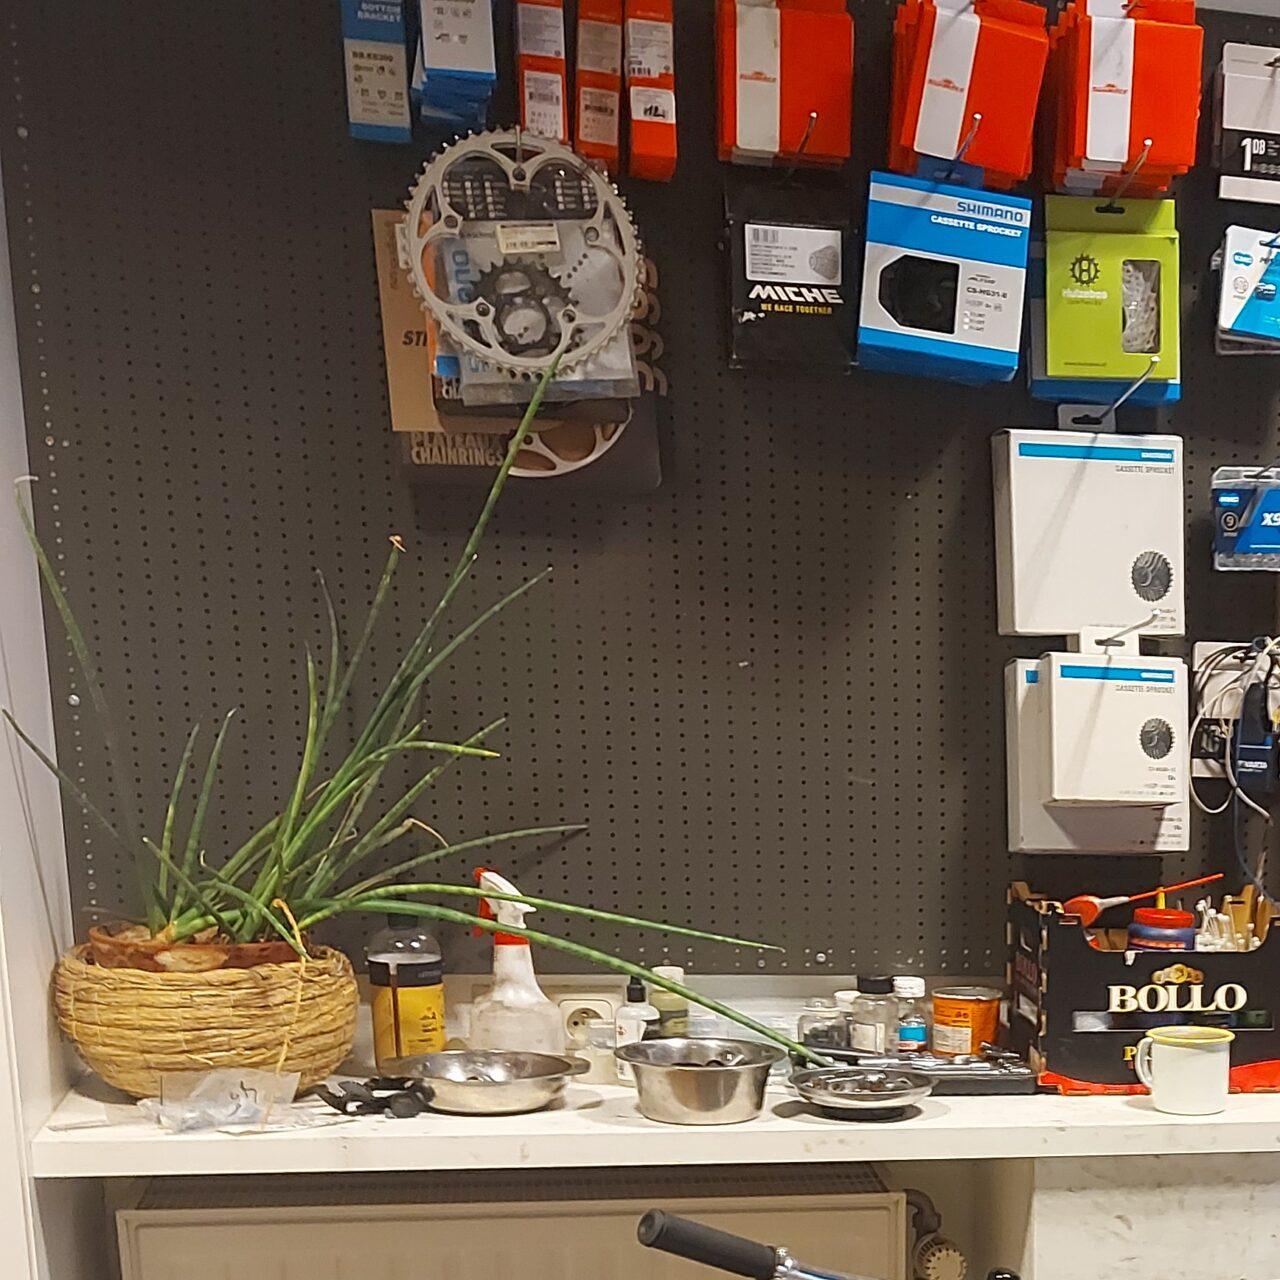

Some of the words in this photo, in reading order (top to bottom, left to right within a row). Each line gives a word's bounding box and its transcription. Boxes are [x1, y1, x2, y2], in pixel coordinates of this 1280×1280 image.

[957, 201, 1023, 222] SHIMANO
[930, 214, 976, 230] CASSETTE
[976, 223, 1022, 238] SPROCKET
[748, 284, 844, 304] MICHE
[761, 303, 772, 311] WE
[774, 304, 793, 312] RACE
[796, 305, 832, 315] TOGETHER
[411, 447, 504, 466] CHAINRINGS
[1107, 983, 1248, 1013] BOLLO
